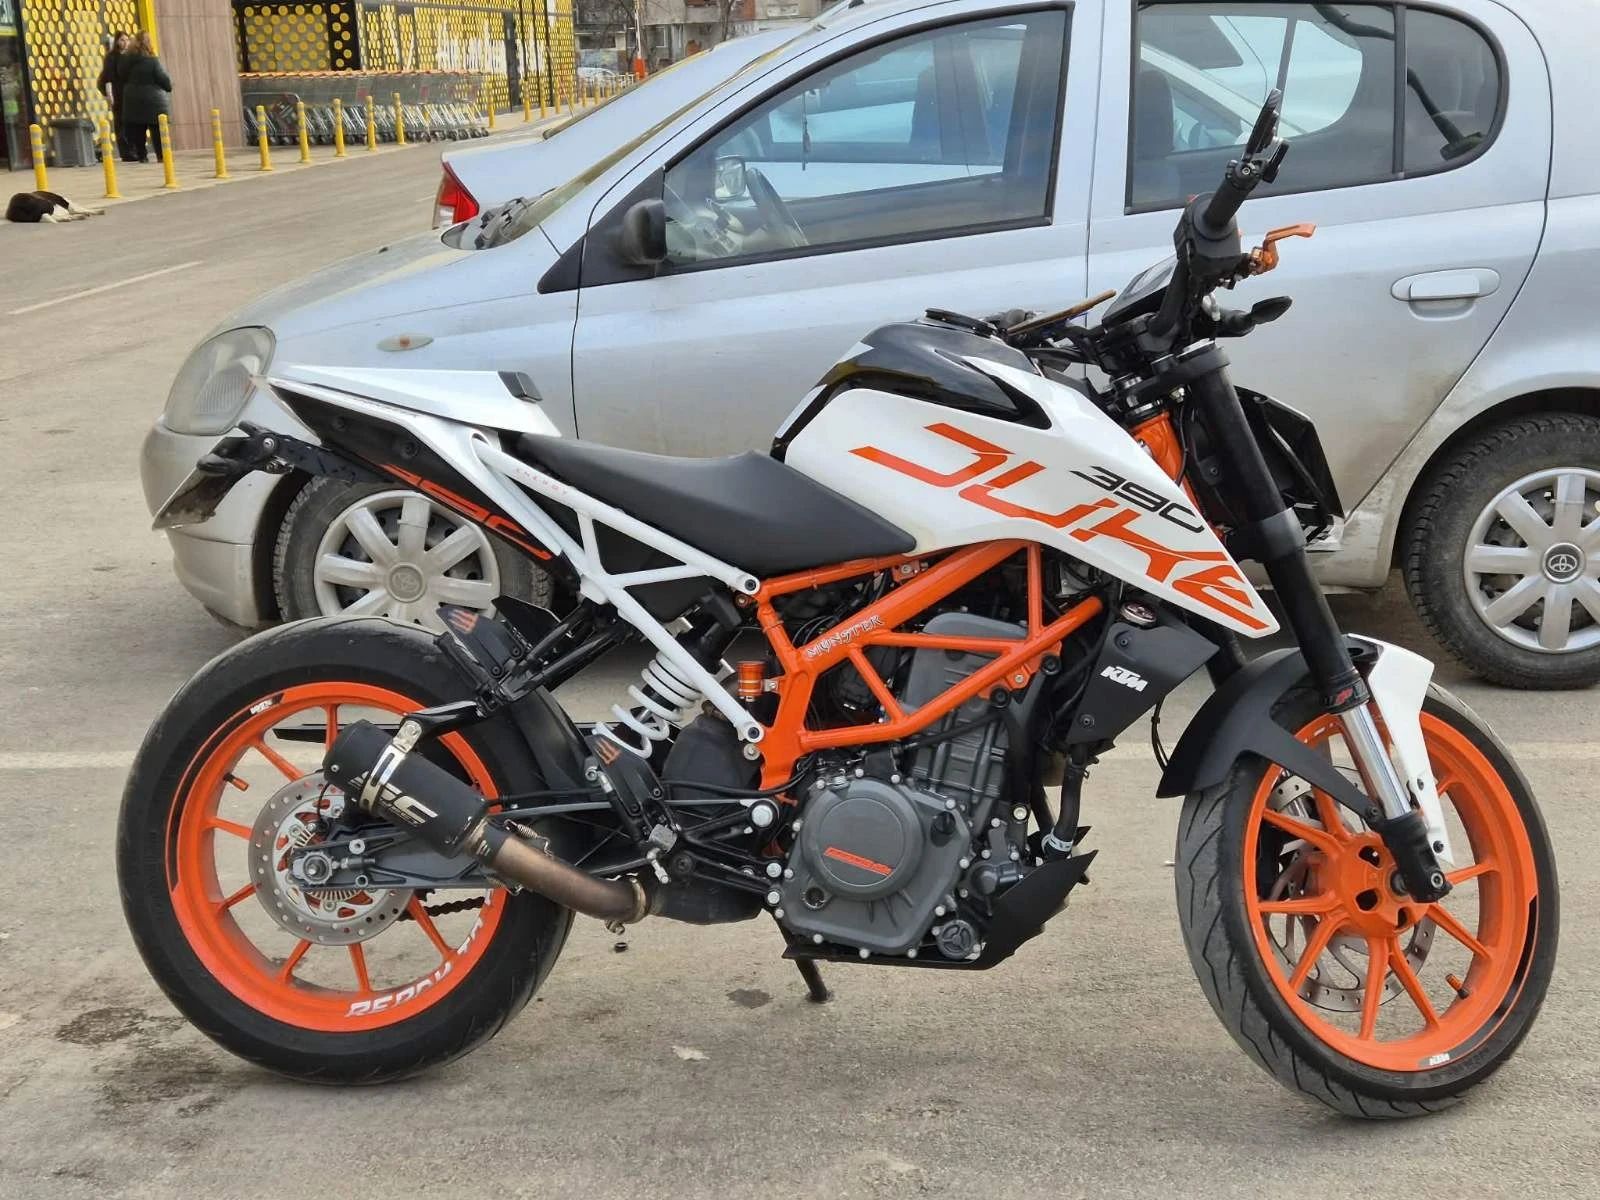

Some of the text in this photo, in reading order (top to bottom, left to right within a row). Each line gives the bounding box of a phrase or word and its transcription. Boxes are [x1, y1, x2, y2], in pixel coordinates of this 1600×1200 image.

[848, 422, 1269, 630] DUKE
[1069, 465, 1205, 533] 390
[1100, 665, 1148, 692] KTM
